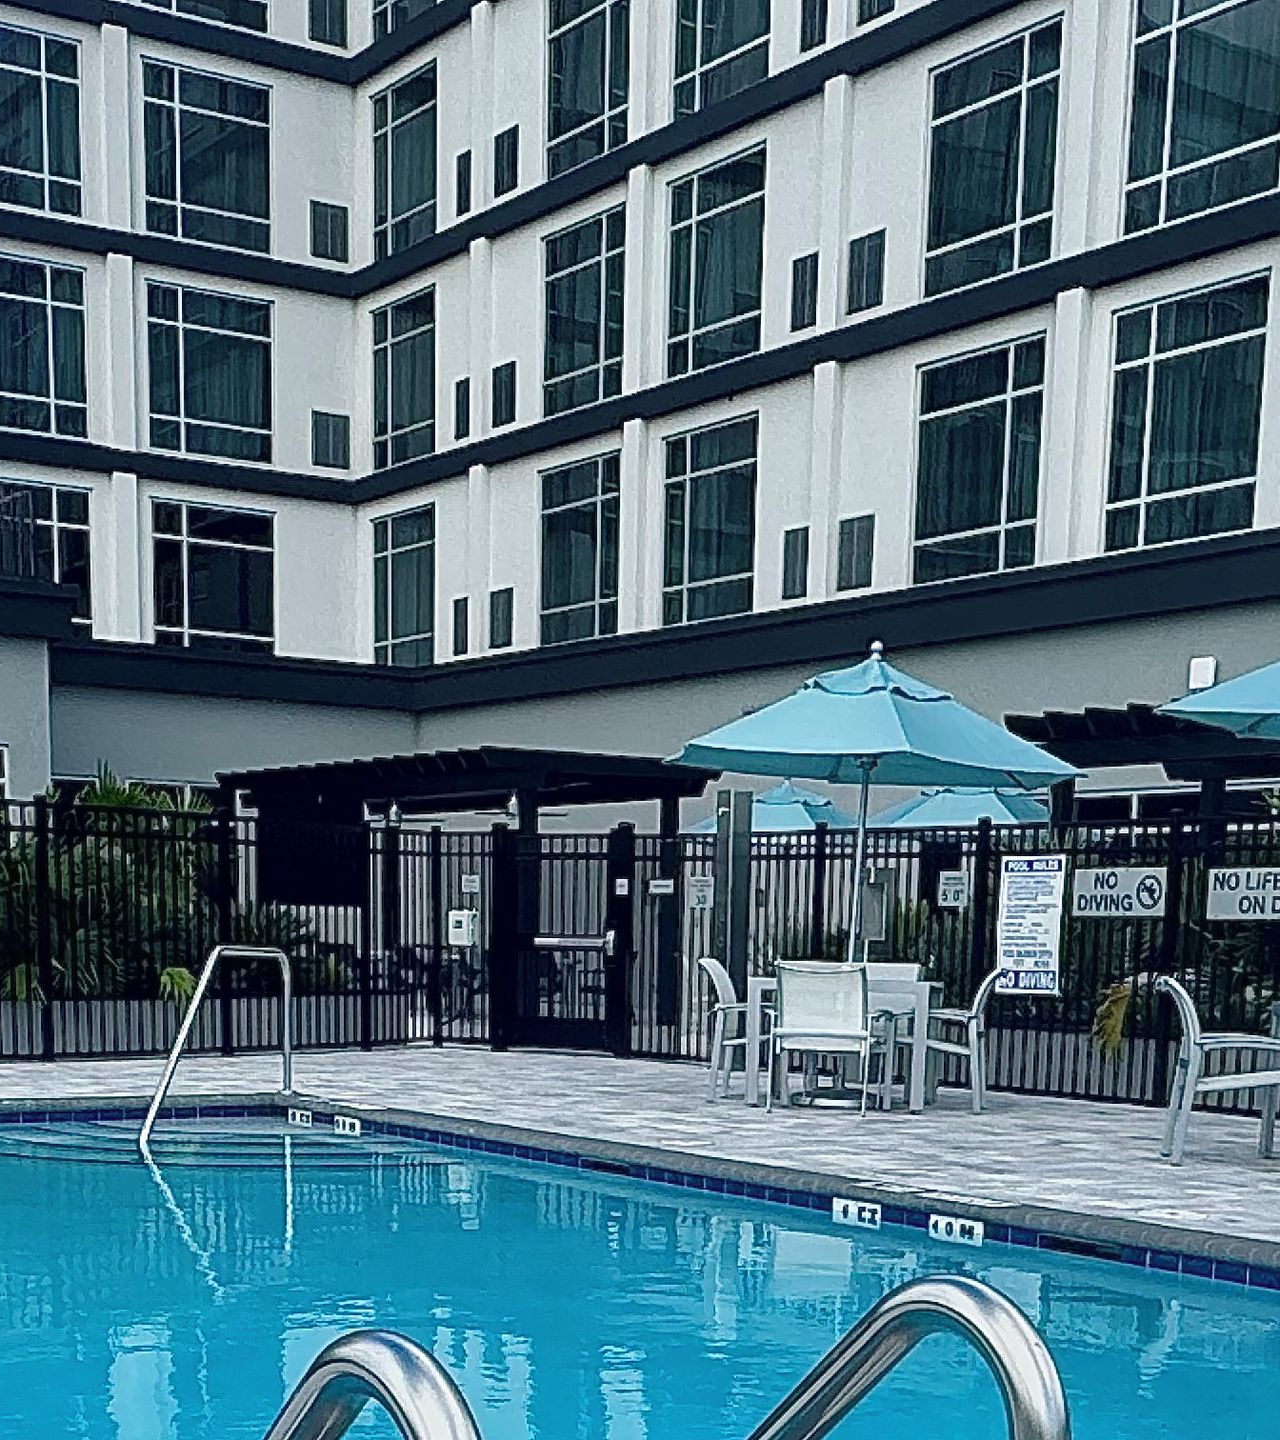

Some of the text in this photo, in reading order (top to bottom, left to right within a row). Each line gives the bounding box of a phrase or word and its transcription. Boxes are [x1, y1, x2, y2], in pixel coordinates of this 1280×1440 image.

[1093, 871, 1118, 890] NO
[1213, 871, 1240, 891] NO
[1077, 894, 1134, 912] DIVING
[1238, 895, 1266, 915] ON
